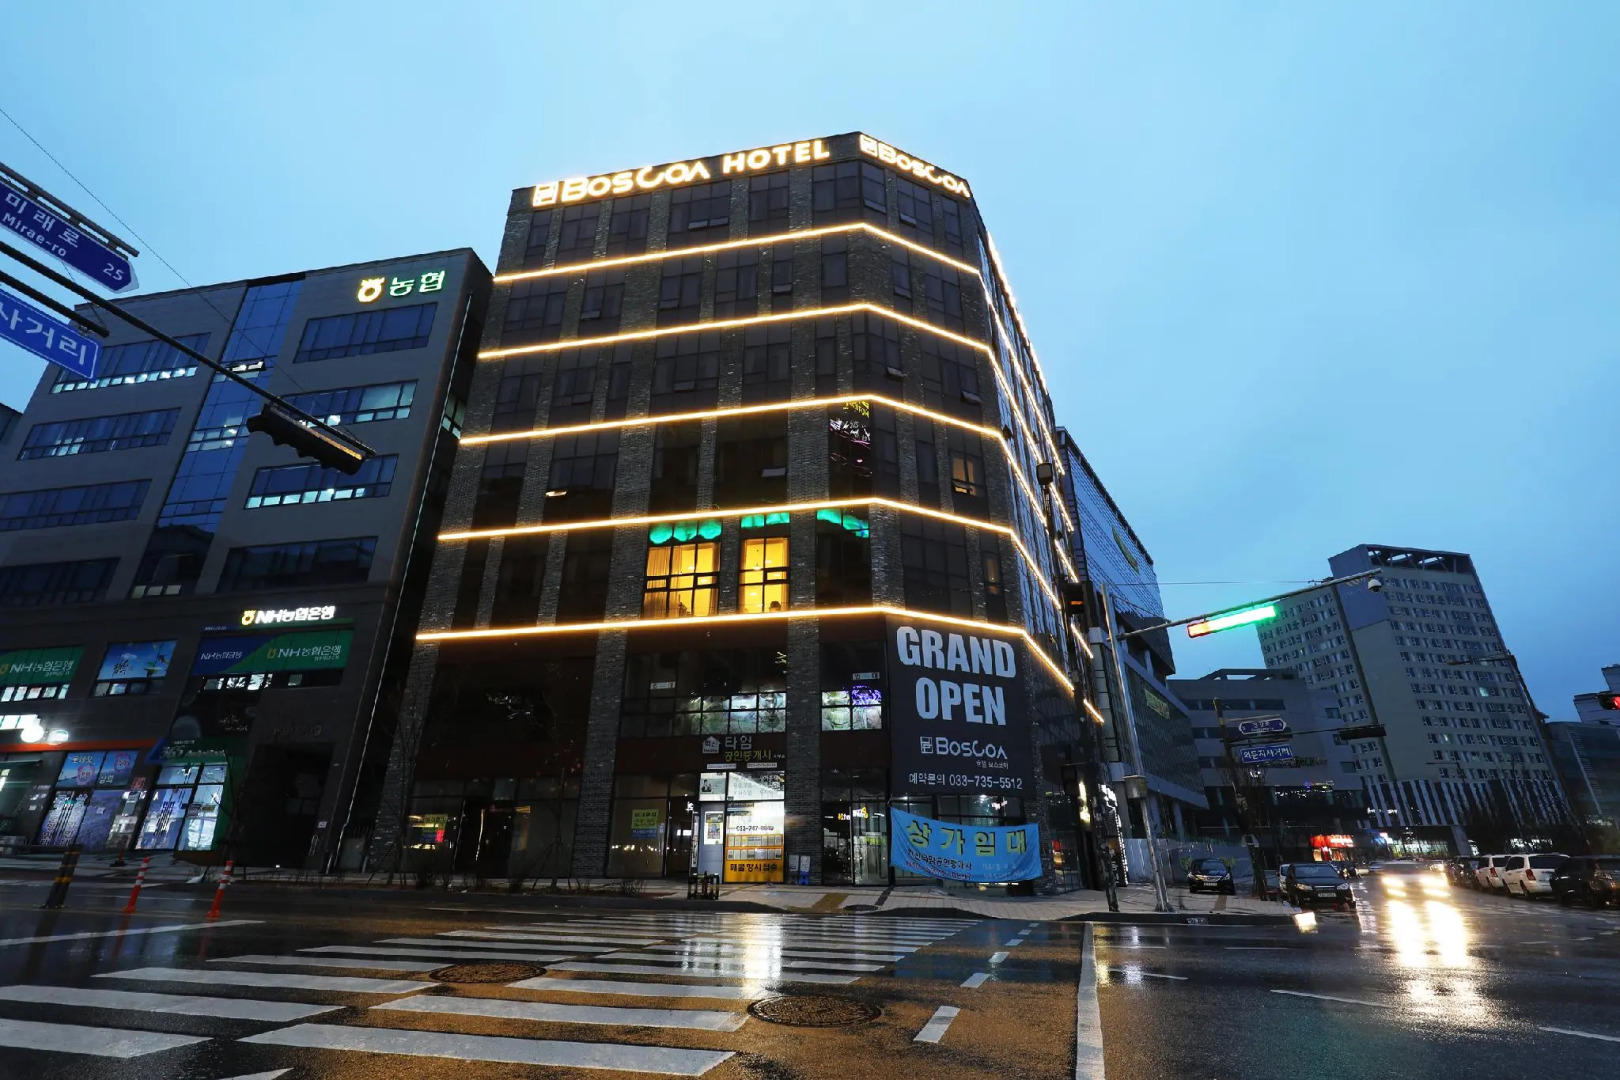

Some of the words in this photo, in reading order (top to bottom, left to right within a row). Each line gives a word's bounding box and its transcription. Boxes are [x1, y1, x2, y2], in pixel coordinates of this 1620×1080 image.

[722, 138, 830, 175] HOTEL
[3, 212, 68, 258] Mirae-ro
[5, 192, 80, 248] 미래로
[102, 262, 124, 281] 25
[389, 270, 445, 297] 농협
[277, 644, 342, 659] NH농협은행
[896, 625, 1017, 679] GRAND
[915, 676, 1006, 726] OPEN
[724, 735, 752, 750] 타임
[908, 772, 946, 786] 예약문의
[949, 773, 1023, 790] 033-735-5512
